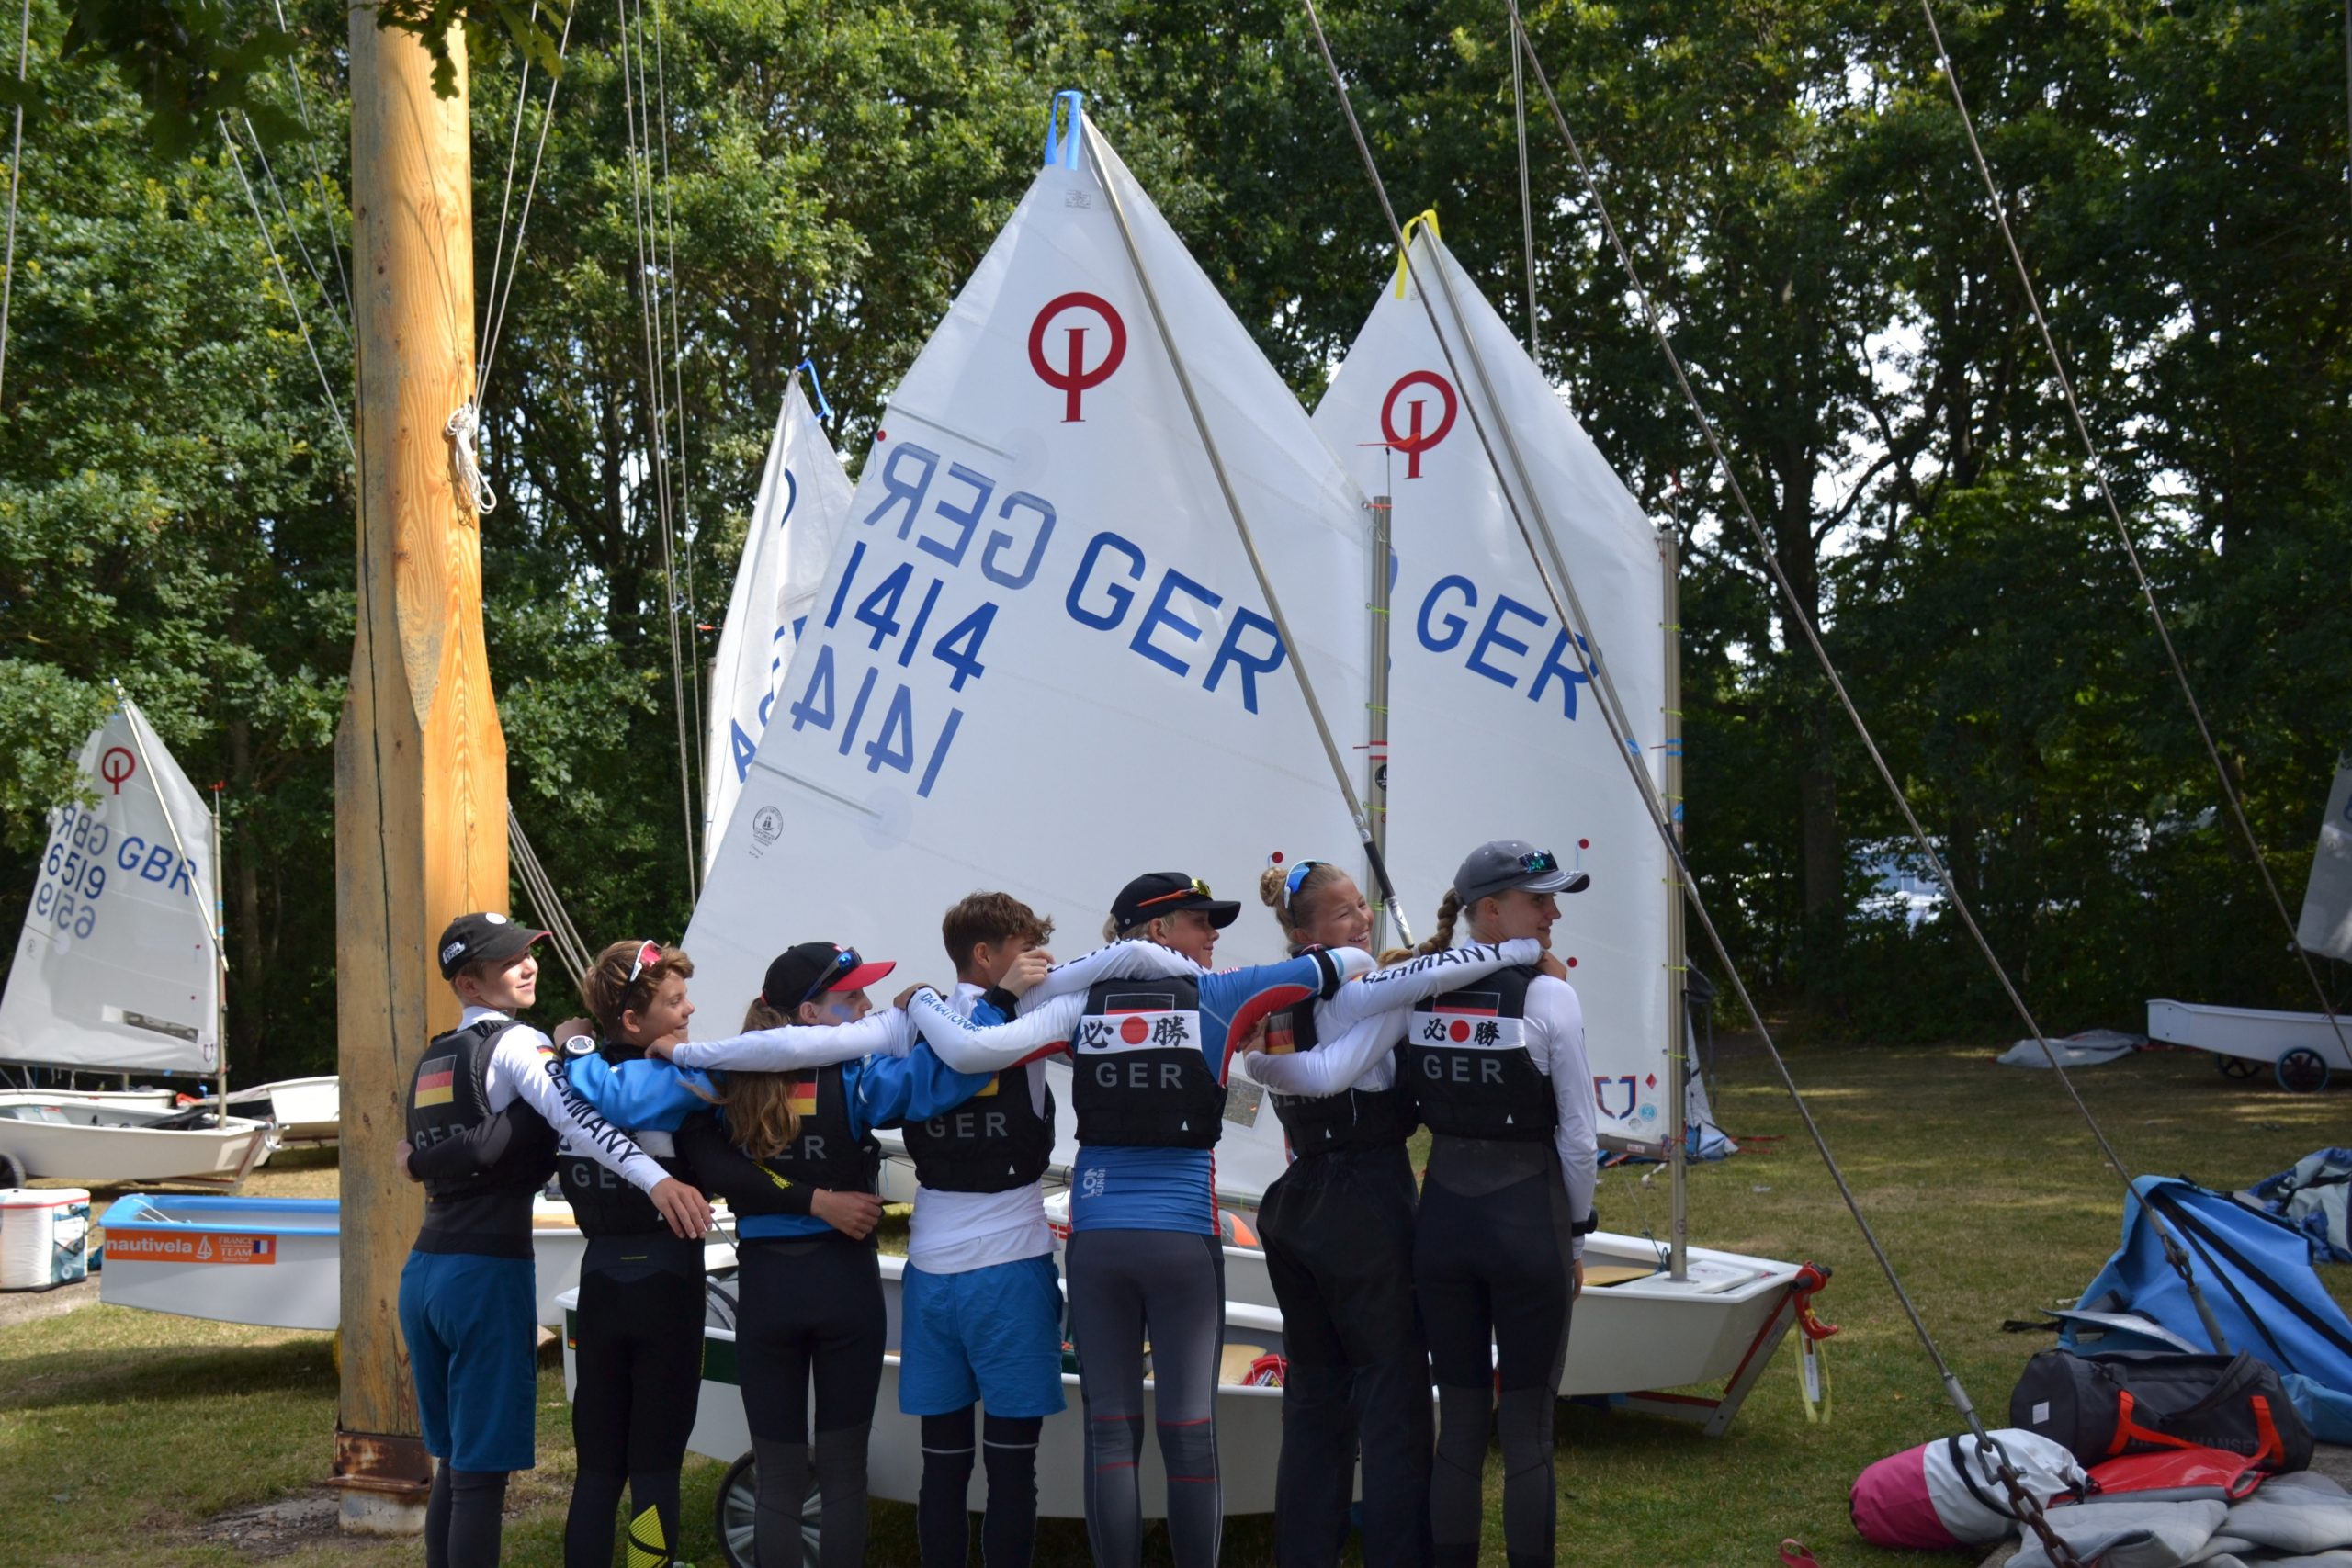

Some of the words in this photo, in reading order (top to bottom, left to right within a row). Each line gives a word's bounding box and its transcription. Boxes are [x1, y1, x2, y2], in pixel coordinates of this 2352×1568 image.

[824, 540, 999, 693] 1414
[1065, 531, 1287, 715] GER
[1416, 574, 1603, 721] GER
[47, 842, 106, 899] 6519
[118, 836, 197, 896] GBR
[1096, 1062, 1183, 1089] GER
[1423, 1054, 1505, 1083] GER
[926, 1111, 1008, 1138] GER
[572, 1162, 634, 1190] GE
[106, 1237, 193, 1254] nautivela
[219, 1236, 254, 1245] FRANCE
[220, 1247, 252, 1258] TEAM
